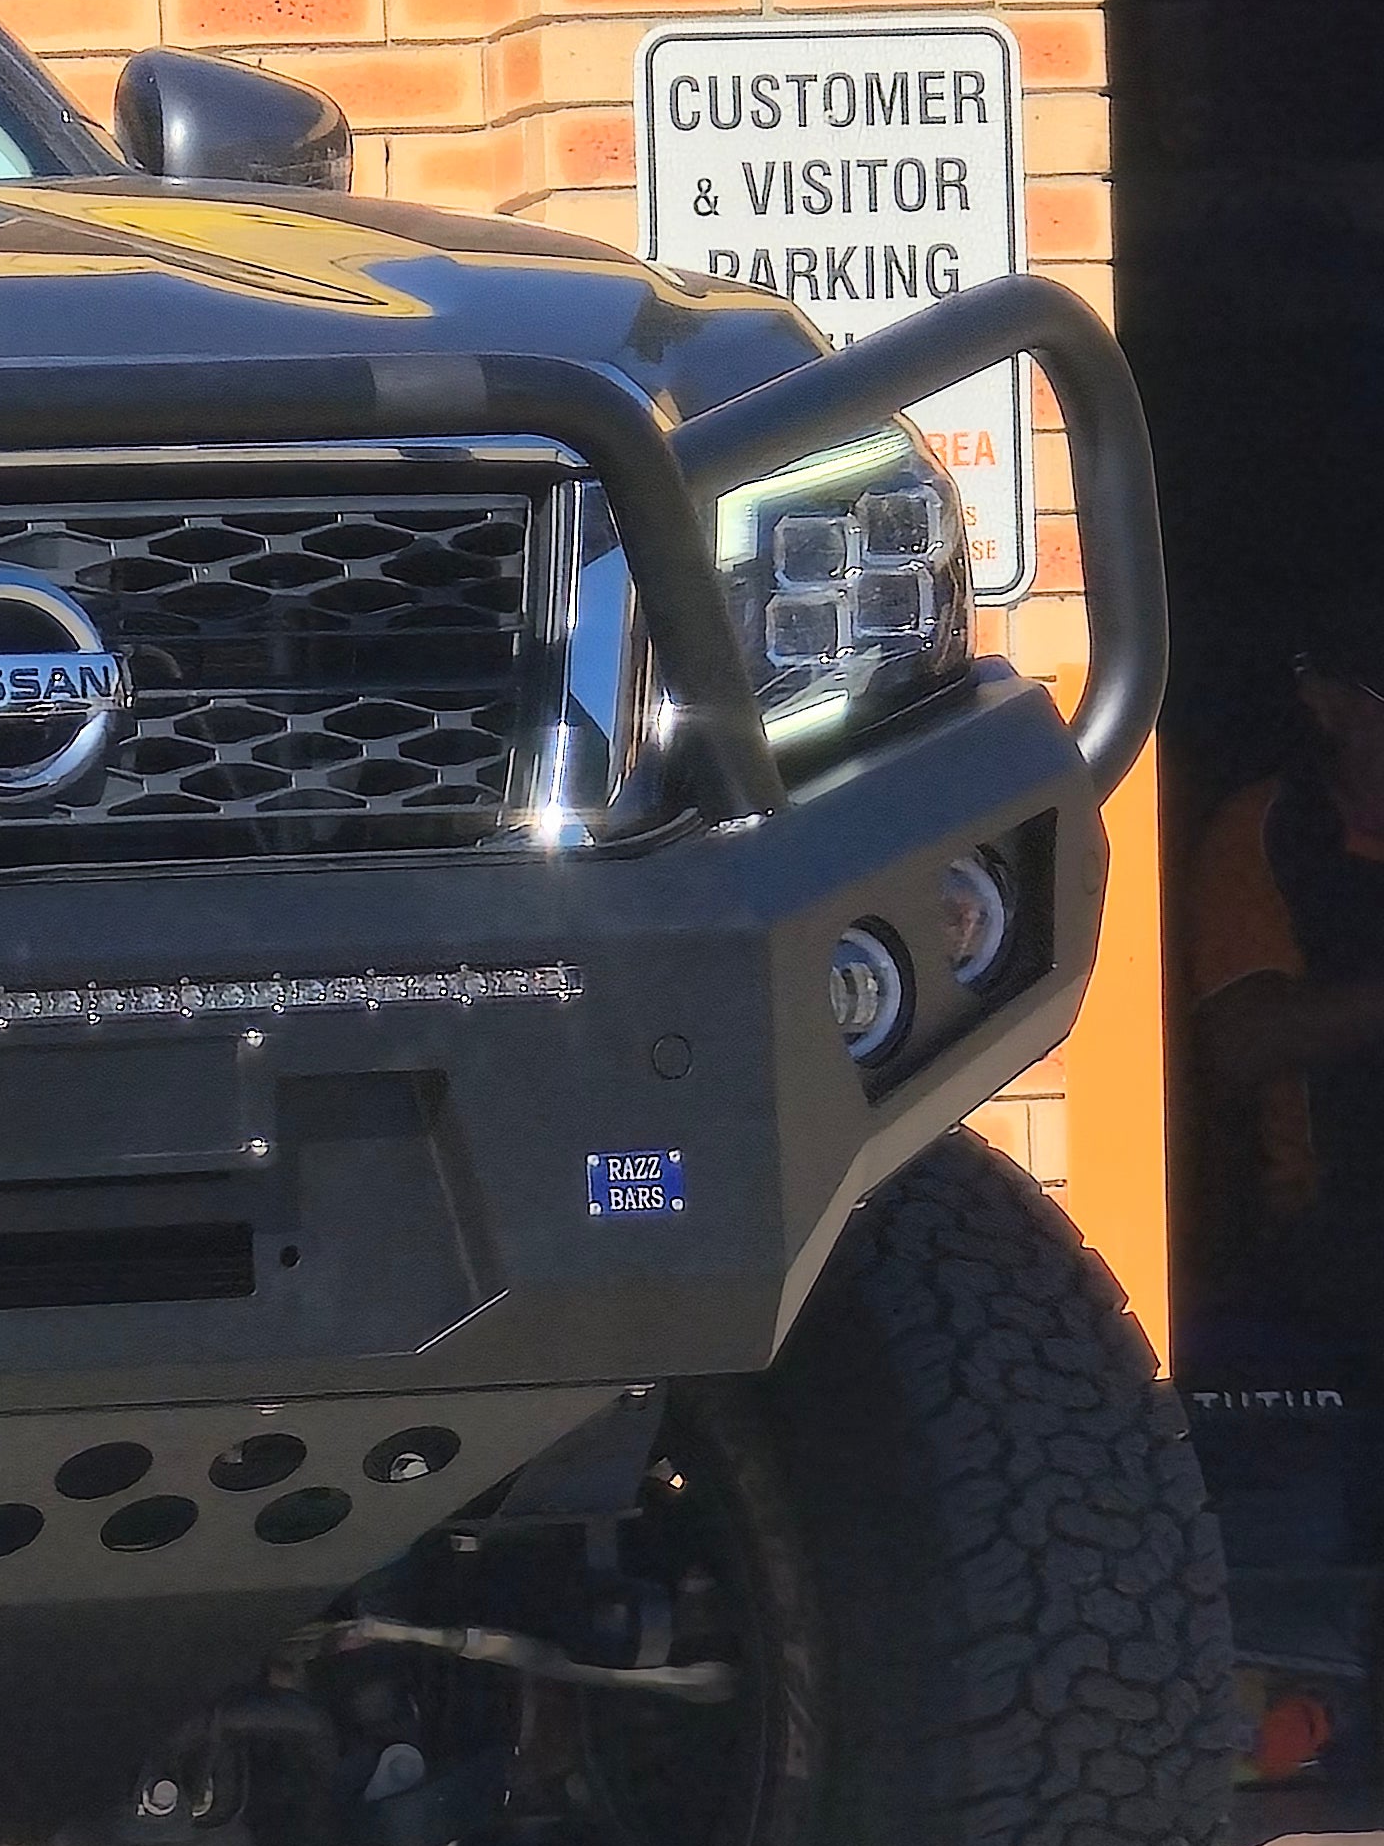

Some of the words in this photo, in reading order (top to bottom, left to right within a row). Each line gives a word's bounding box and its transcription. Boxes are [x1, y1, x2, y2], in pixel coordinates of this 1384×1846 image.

[669, 70, 989, 131] CUSTOMER
[693, 178, 720, 216] &
[741, 157, 971, 216] VISITOR
[708, 243, 960, 301] PARKING
[924, 431, 996, 467] REA
[608, 1156, 661, 1181] RAZZ
[609, 1186, 665, 1210] BARS
